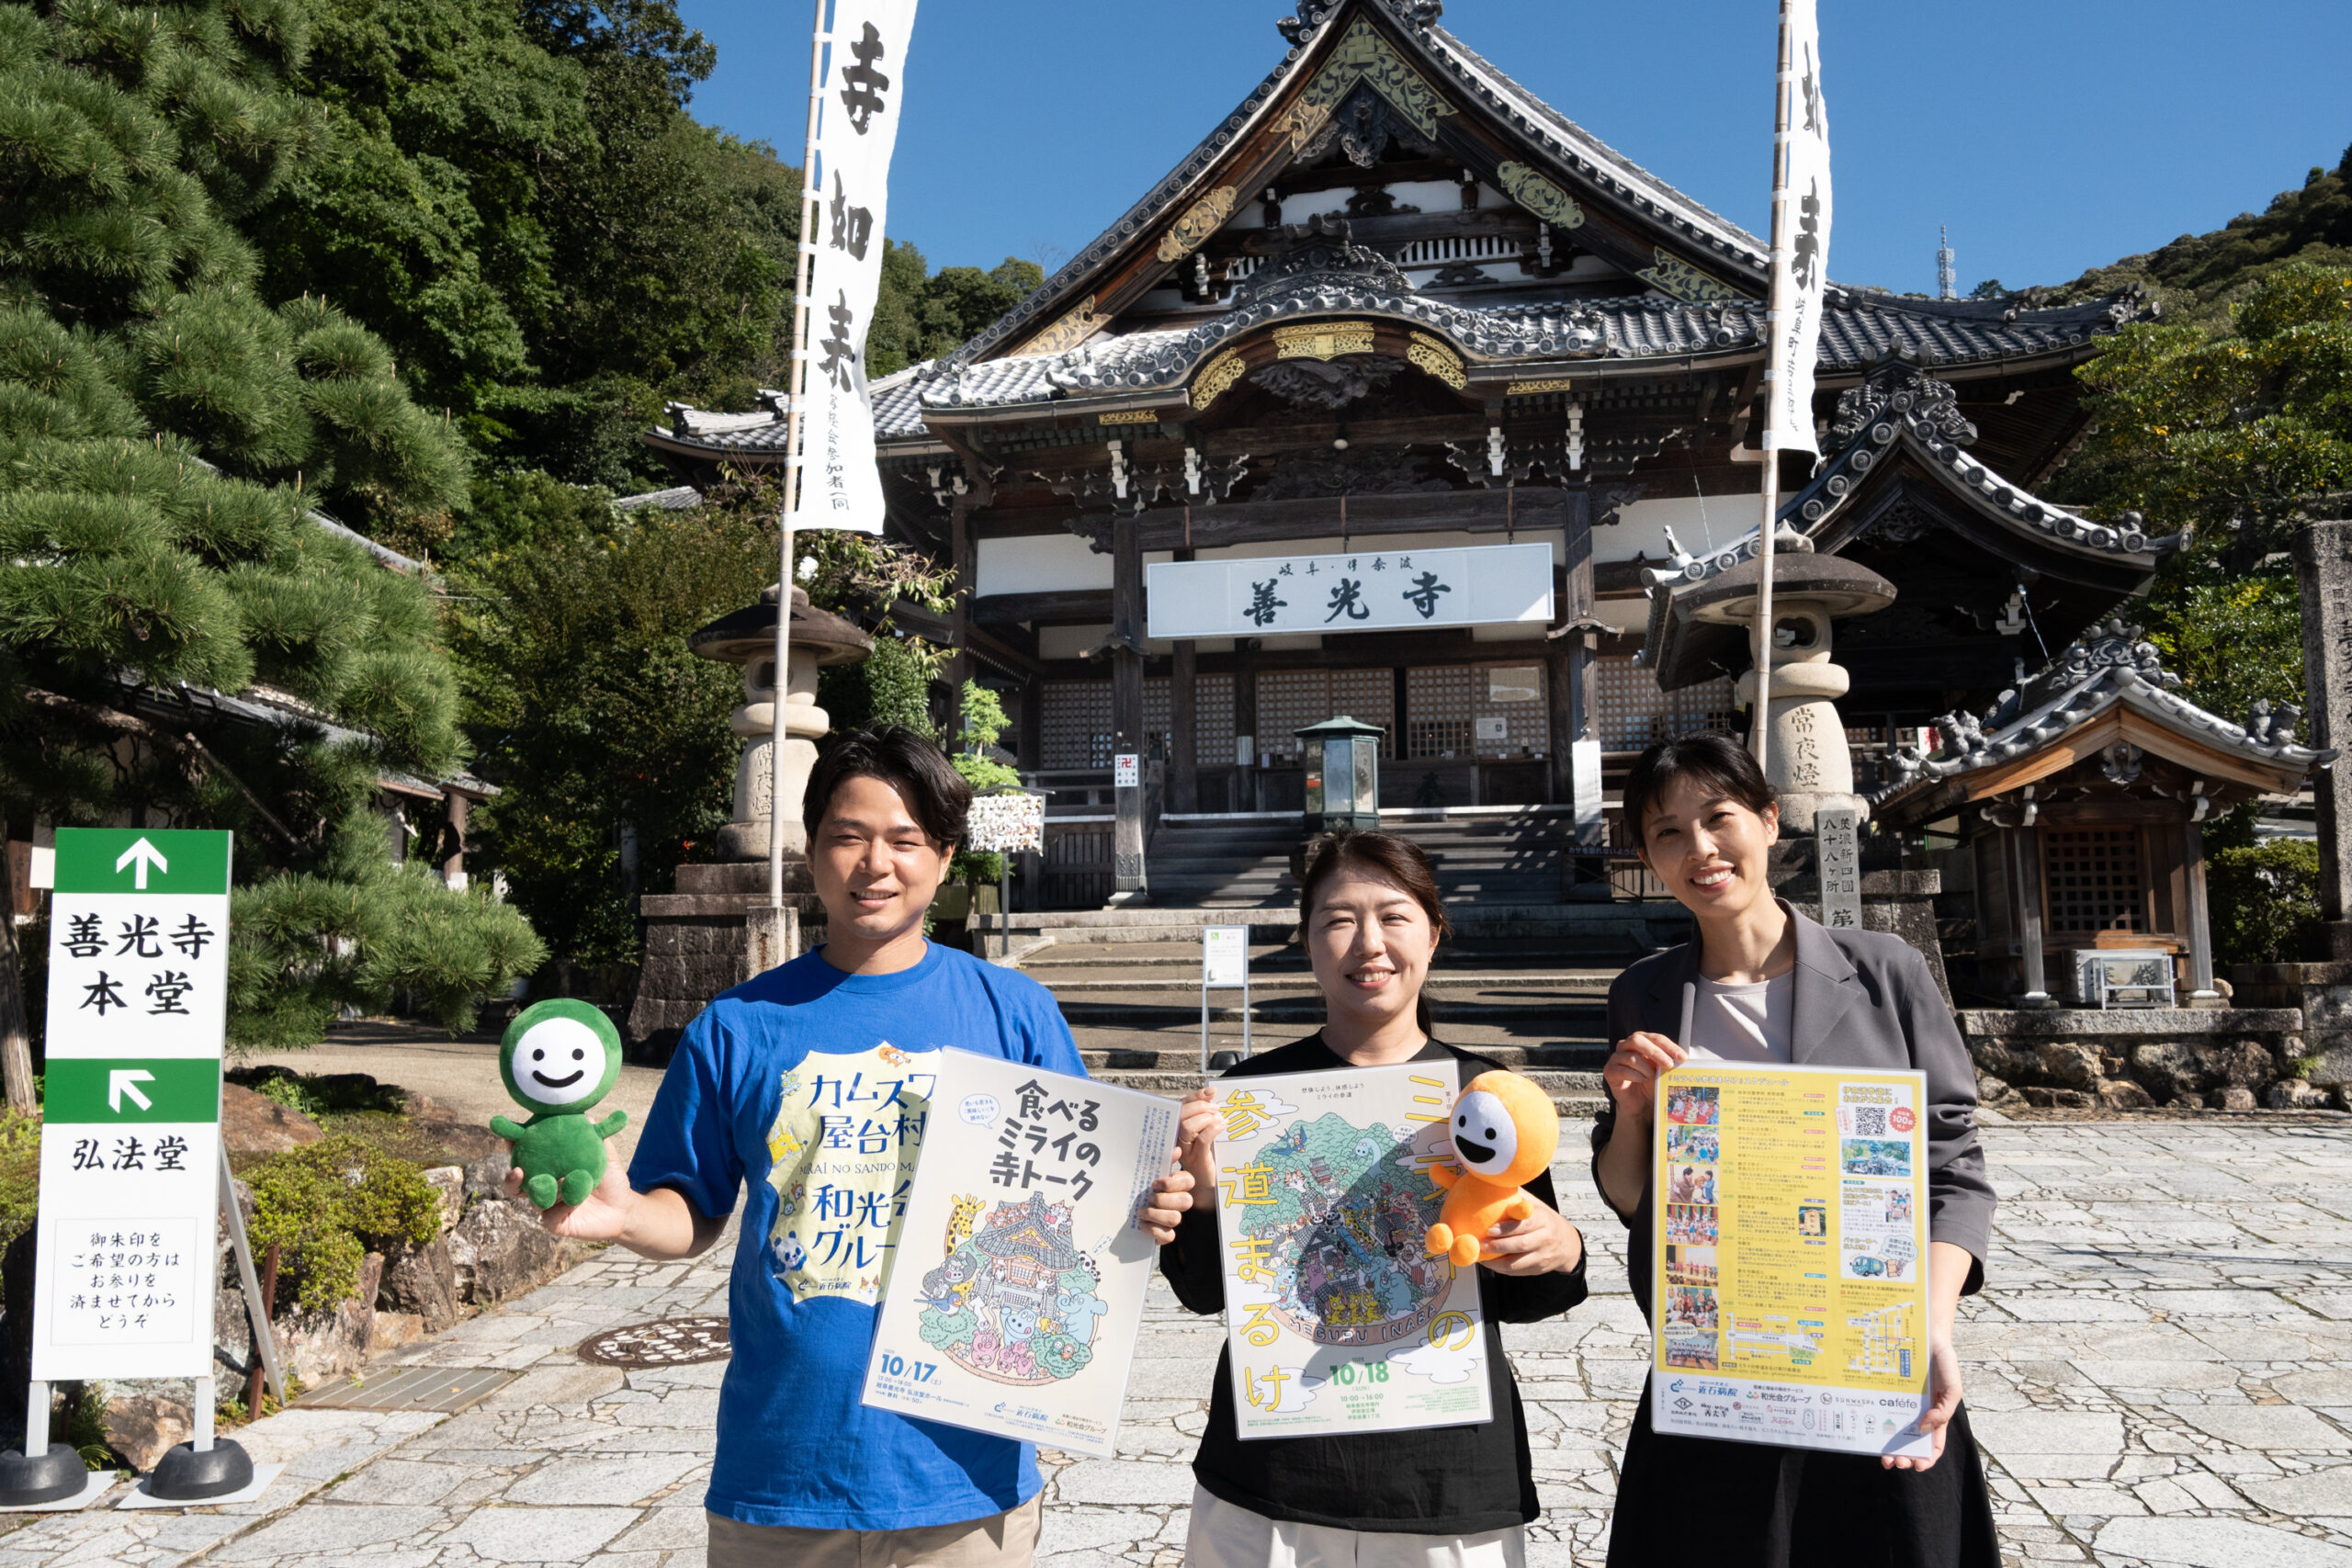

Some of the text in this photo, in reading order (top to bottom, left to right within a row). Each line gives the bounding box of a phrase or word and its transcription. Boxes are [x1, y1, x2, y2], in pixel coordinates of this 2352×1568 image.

[1243, 570, 1452, 627] 善光寺
[60, 912, 215, 960] 善光寺
[78, 970, 194, 1017] 本堂
[1015, 1079, 1101, 1132] 食べる
[816, 1111, 927, 1156] 屋台村
[998, 1117, 1102, 1168] ミライの
[71, 1135, 189, 1172] 弘法堂
[831, 1164, 851, 1175] NO
[854, 1162, 896, 1175] SANDO
[989, 1151, 1093, 1201] 寺トーク
[90, 1231, 161, 1247] 御朱印を
[71, 1252, 180, 1269] ご希望の方は
[90, 1272, 156, 1288] お参りを
[70, 1292, 176, 1310] 済ませてから
[98, 1313, 149, 1329] どうぞ
[1288, 1303, 1437, 1343] MEGURU INABA
[881, 1353, 938, 1382] 10/17
[1329, 1360, 1389, 1386] 10/18
